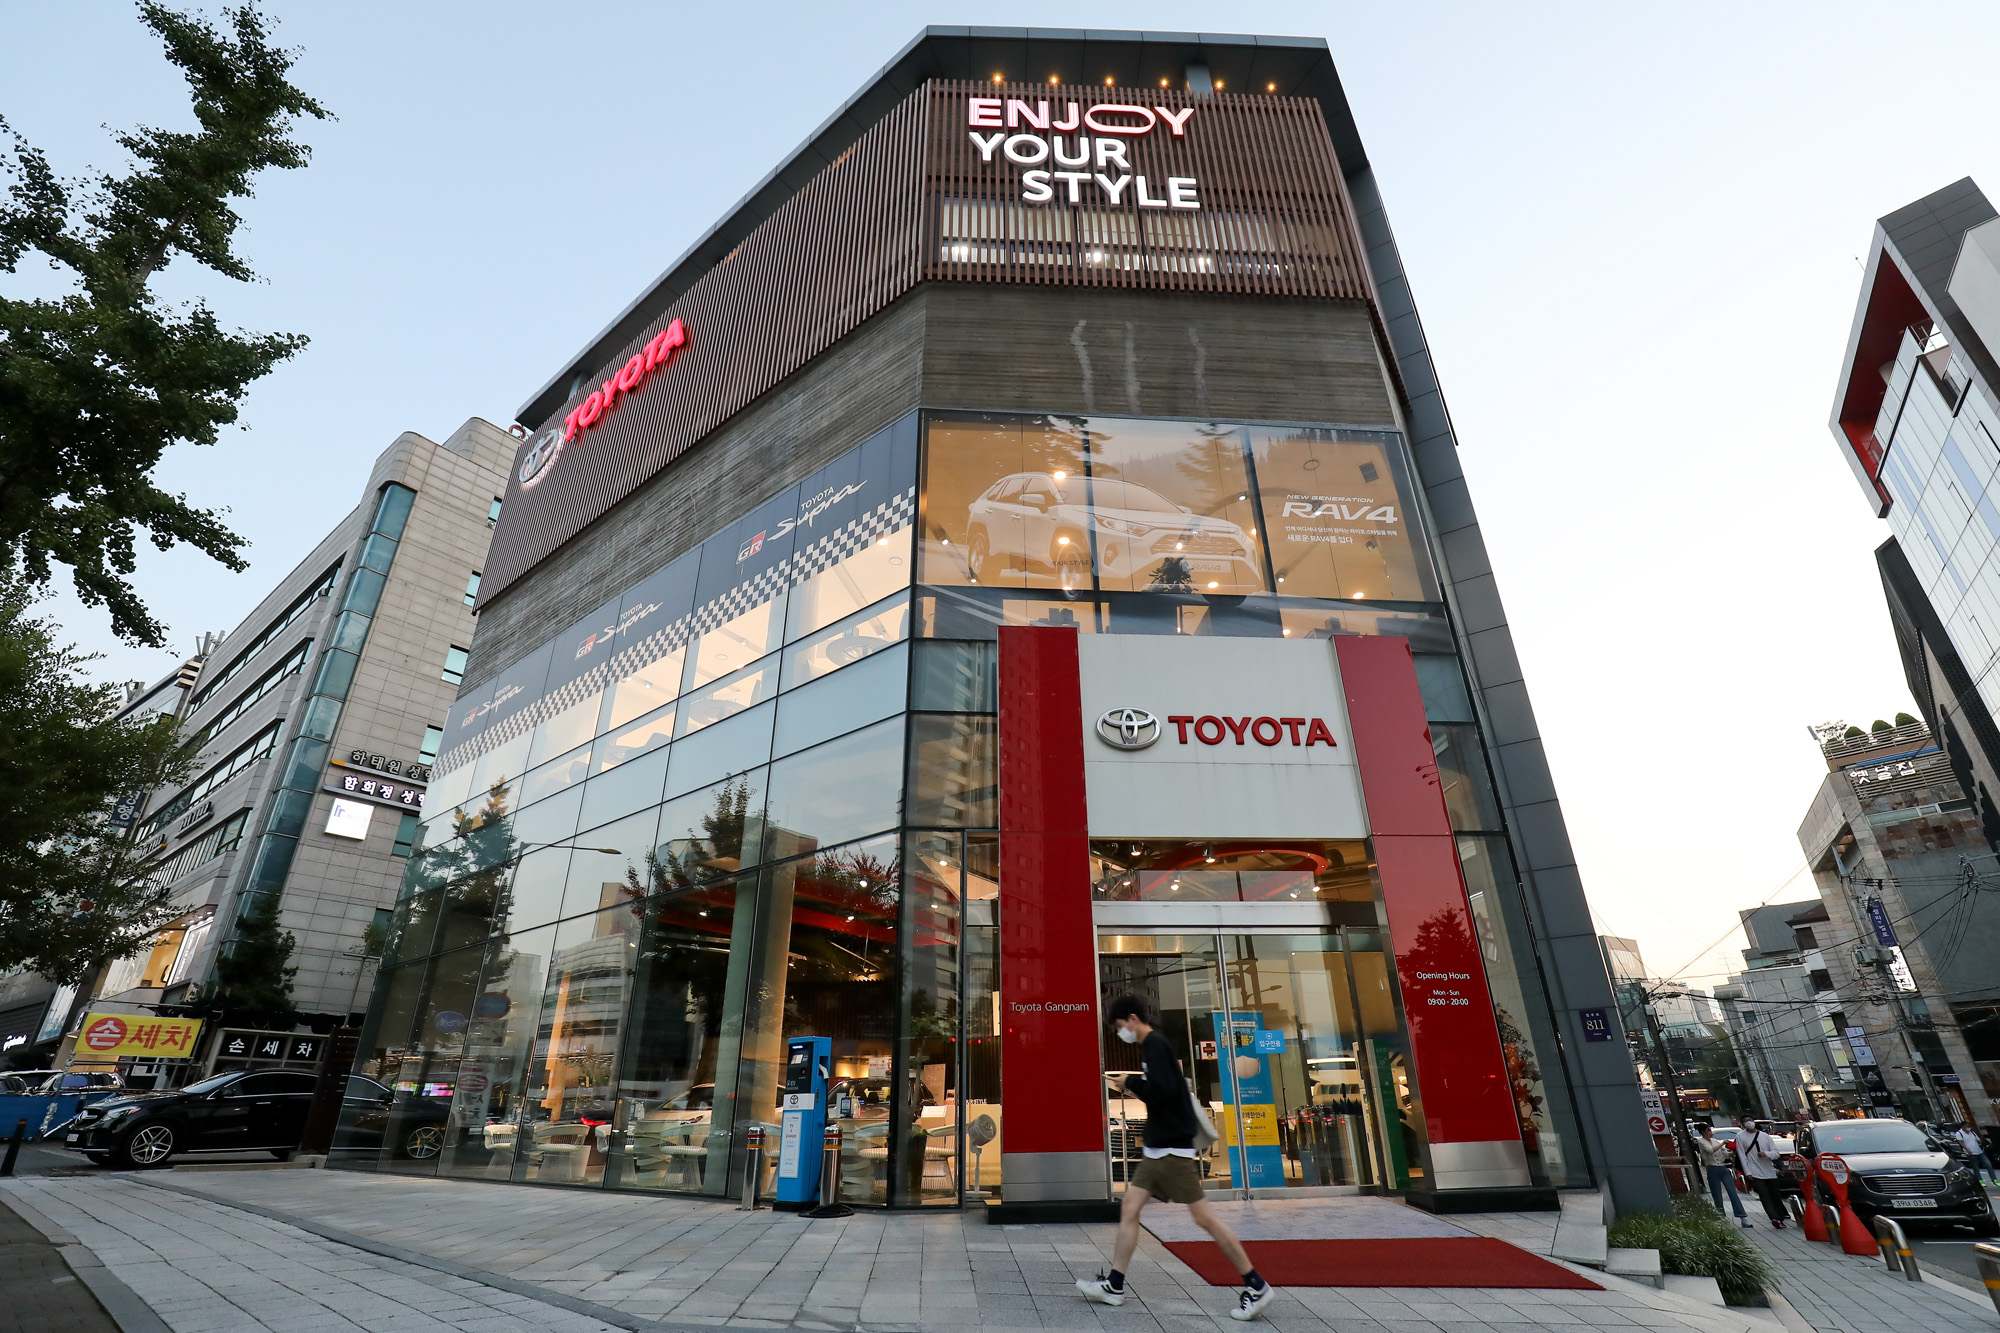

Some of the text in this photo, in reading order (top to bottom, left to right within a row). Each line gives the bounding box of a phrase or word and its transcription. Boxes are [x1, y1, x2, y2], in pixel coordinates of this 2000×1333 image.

[968, 97, 1195, 137] ENJOY
[968, 131, 1131, 171] YOUR
[1022, 169, 1200, 210] STYLE
[565, 317, 686, 443] TOYOTA
[801, 486, 834, 511] TOYOTA
[1311, 495, 1374, 503] GENERATION
[738, 479, 868, 562] GR Supra
[1282, 501, 1398, 524] RAV4
[1287, 534, 1309, 543] 새로운
[596, 602, 664, 644] Supra
[620, 603, 643, 621] TOYOTA
[477, 686, 526, 716] Supra
[1168, 715, 1337, 747] TOYOTA
[352, 750, 402, 775] 하태원
[1850, 761, 1916, 785] 옛날집
[344, 776, 394, 799] 함희정
[1416, 971, 1470, 982] Opening Hours
[1010, 1002, 1090, 1014] Toyota Gangnam
[1428, 998, 1446, 1006] 09:00
[1451, 998, 1469, 1006] 20:00
[89, 1020, 192, 1051] 손세차
[1587, 1020, 1605, 1031] 811
[228, 1038, 313, 1058] 손세차
